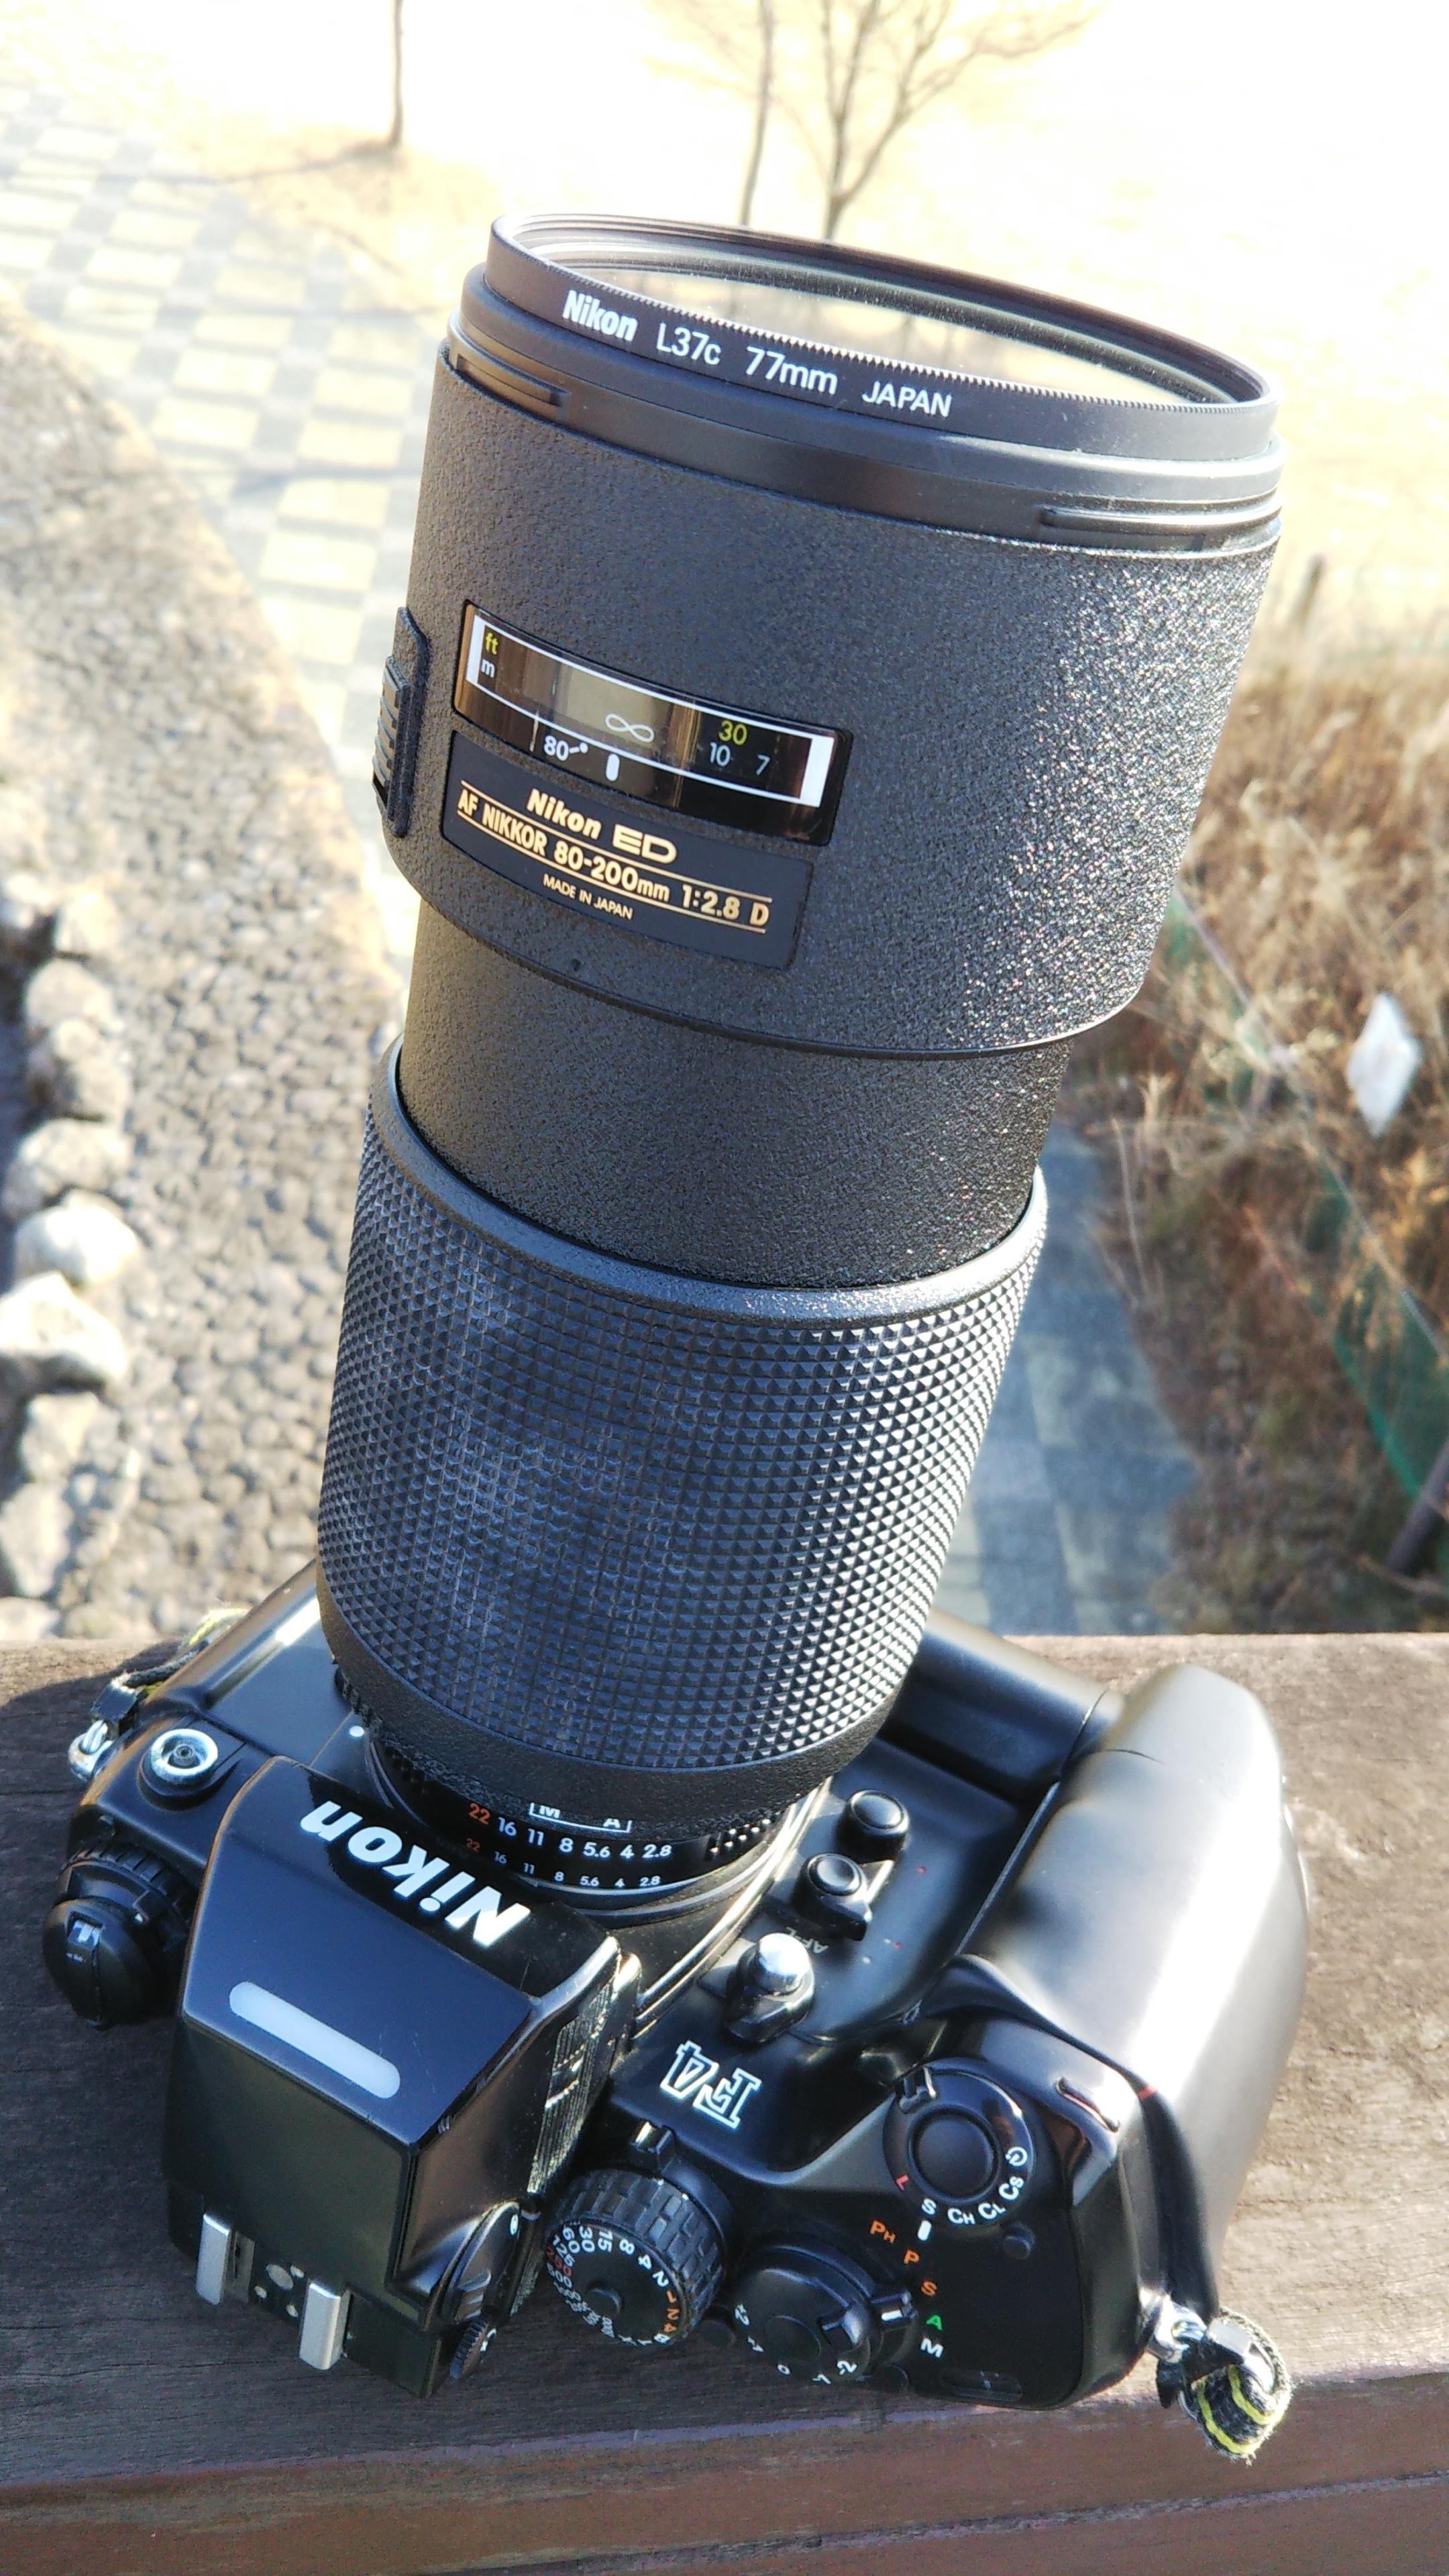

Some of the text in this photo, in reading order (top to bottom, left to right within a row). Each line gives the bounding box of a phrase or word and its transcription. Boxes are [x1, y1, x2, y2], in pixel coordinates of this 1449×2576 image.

[562, 289, 952, 417] Nikon L37c 77mm JAPAN
[485, 632, 498, 655] ft
[481, 657, 496, 678] m
[718, 720, 748, 745] 30
[708, 742, 771, 776] 10 7
[526, 788, 678, 864] Nikon ED
[458, 788, 770, 927] AF NIKKOR 80-200mm 1:2.8 D
[543, 873, 633, 921] MADE IN JAPAN
[469, 1802, 673, 1860] 22 16 11 8 5.6 4 2.8
[299, 1799, 531, 1946] Nikon
[493, 1851, 508, 1865] 16
[523, 1862, 535, 1875] 11
[554, 1871, 565, 1882] 8
[580, 1876, 600, 1887] 5.6
[614, 1878, 625, 1888] 4
[639, 1876, 661, 1887] 2.8
[659, 2039, 762, 2129] F4
[922, 2198, 937, 2216] S
[552, 2235, 576, 2268] 125
[562, 2226, 581, 2255] 60
[578, 2225, 596, 2253] 30
[597, 2230, 614, 2253] 15
[619, 2238, 635, 2256] 8
[637, 2253, 653, 2271] 4
[903, 2249, 920, 2265] P
[546, 2262, 572, 2289] 500
[652, 2270, 669, 2288] 2
[921, 2281, 938, 2297] S
[663, 2322, 678, 2334] 4
[926, 2315, 943, 2331] A
[920, 2338, 944, 2359] M
[777, 2364, 791, 2375] 0
[837, 2360, 858, 2376] -2
